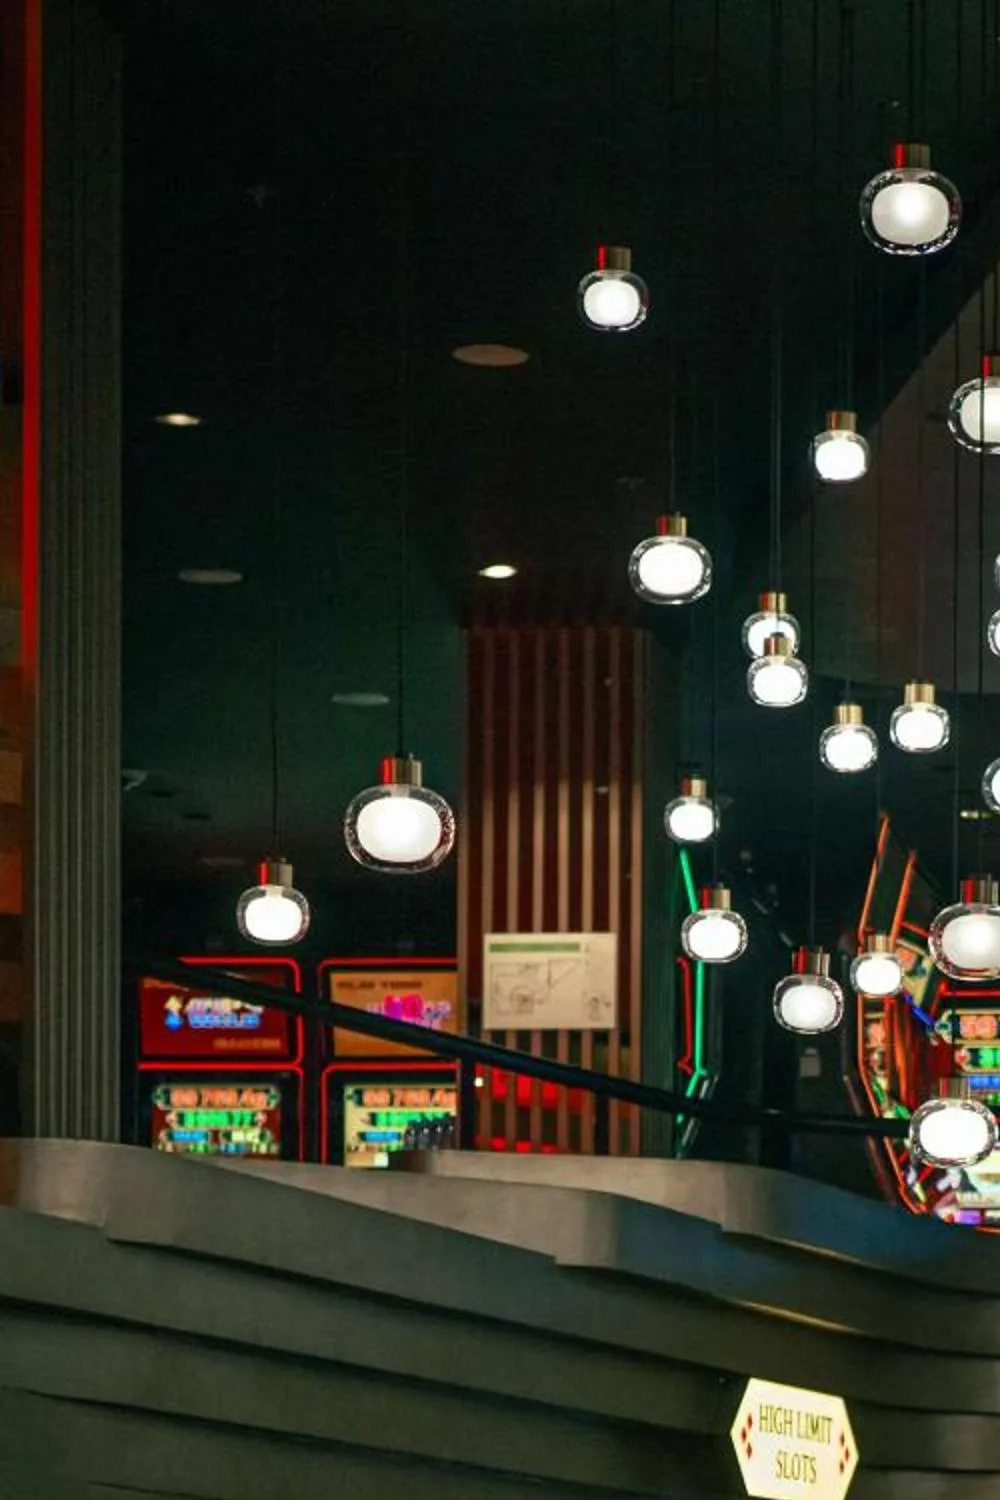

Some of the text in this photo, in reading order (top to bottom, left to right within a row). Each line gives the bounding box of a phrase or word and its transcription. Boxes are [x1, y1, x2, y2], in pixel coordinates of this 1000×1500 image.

[759, 1404, 833, 1445] HIGH LIMIT
[775, 1450, 818, 1484] SLOTS
